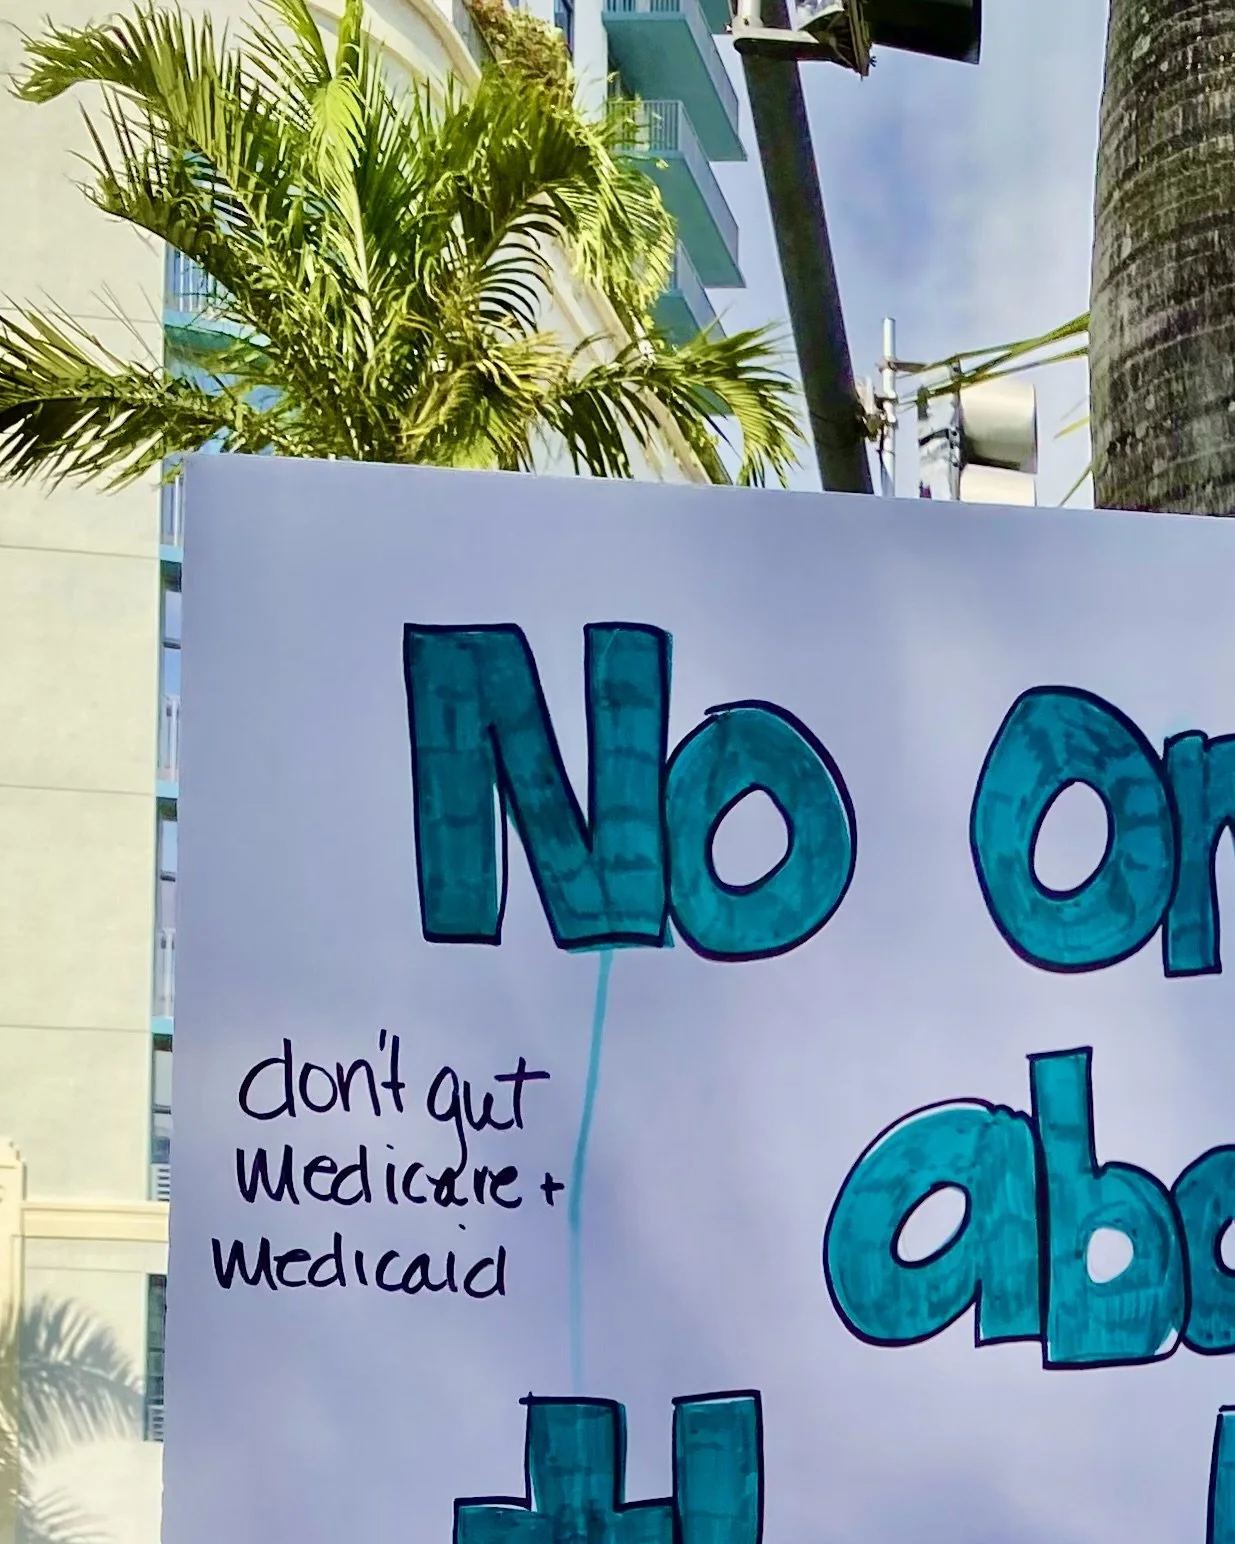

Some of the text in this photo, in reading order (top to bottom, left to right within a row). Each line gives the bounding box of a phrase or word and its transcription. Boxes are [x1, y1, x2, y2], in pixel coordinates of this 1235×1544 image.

[403, 623, 857, 962] No
[240, 1030, 551, 1178] don't gut
